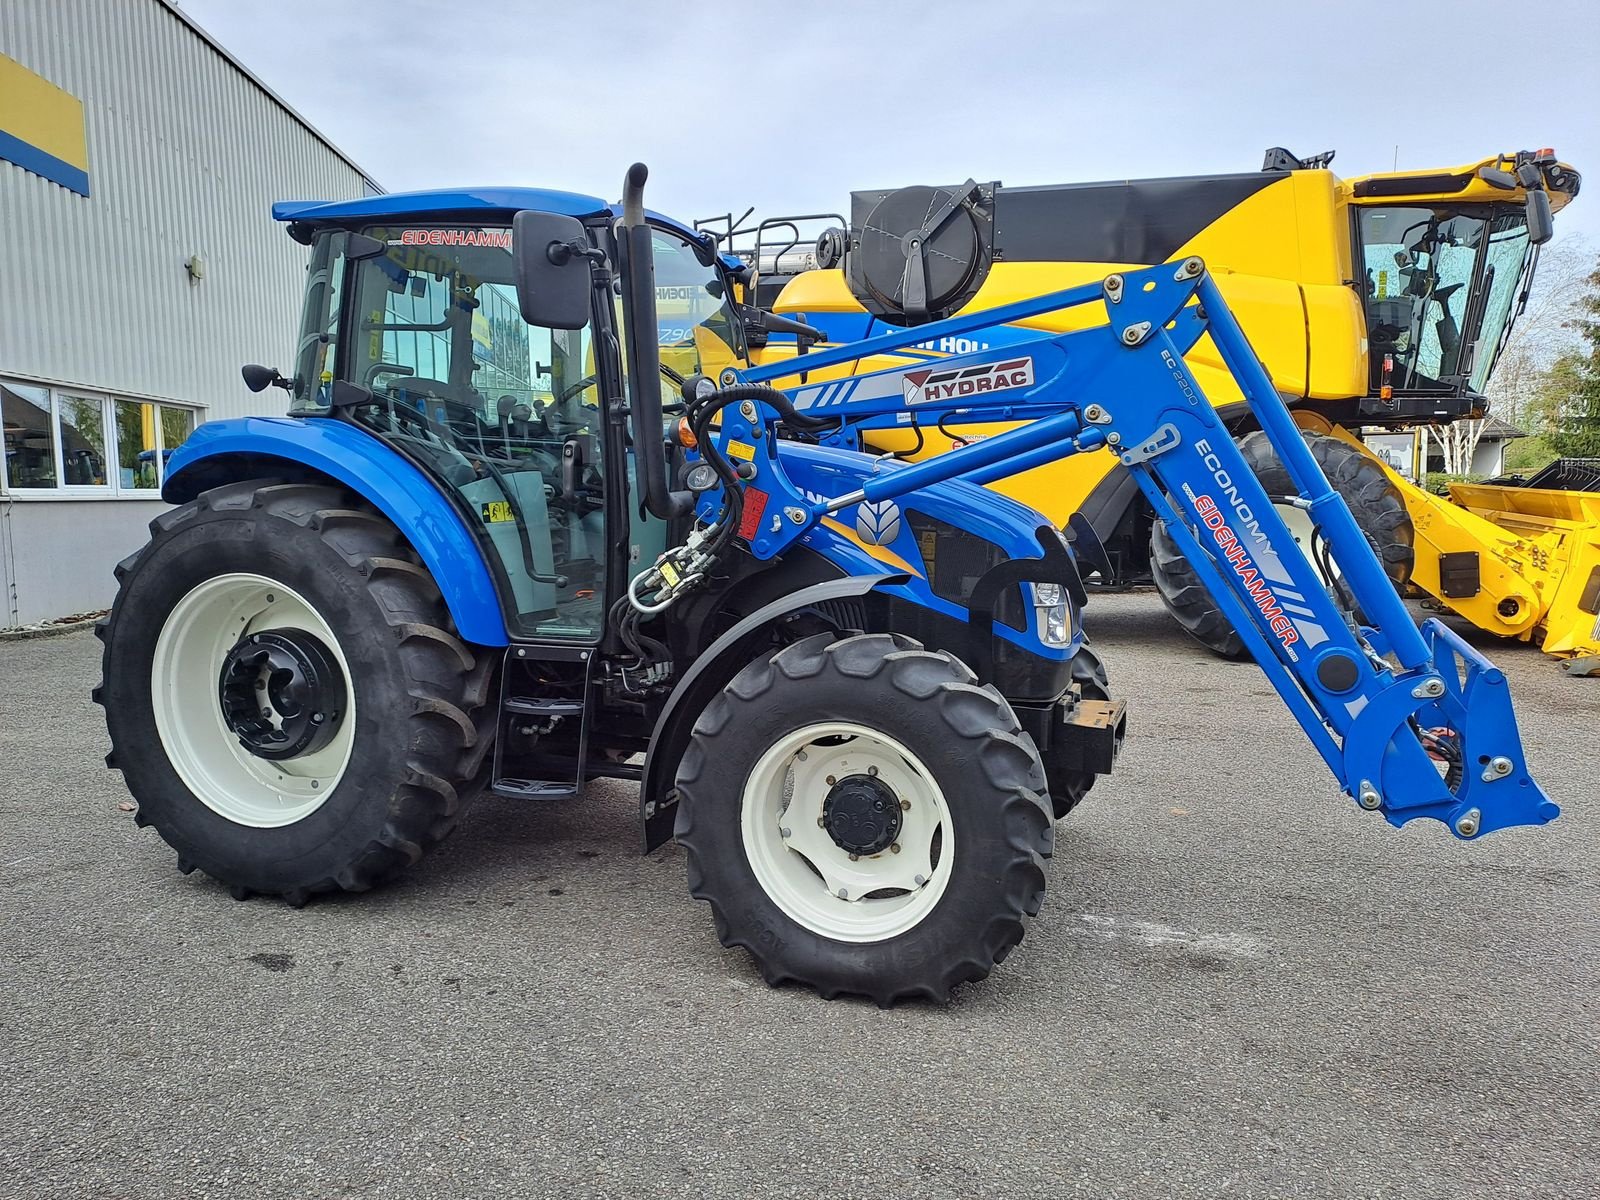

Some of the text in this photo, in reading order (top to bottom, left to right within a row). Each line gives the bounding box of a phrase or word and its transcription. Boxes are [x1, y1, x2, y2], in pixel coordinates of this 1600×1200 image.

[924, 371, 1027, 400] HYDRAC
[1160, 350, 1199, 406] EC 2200
[1194, 438, 1278, 556] ECONOMY
